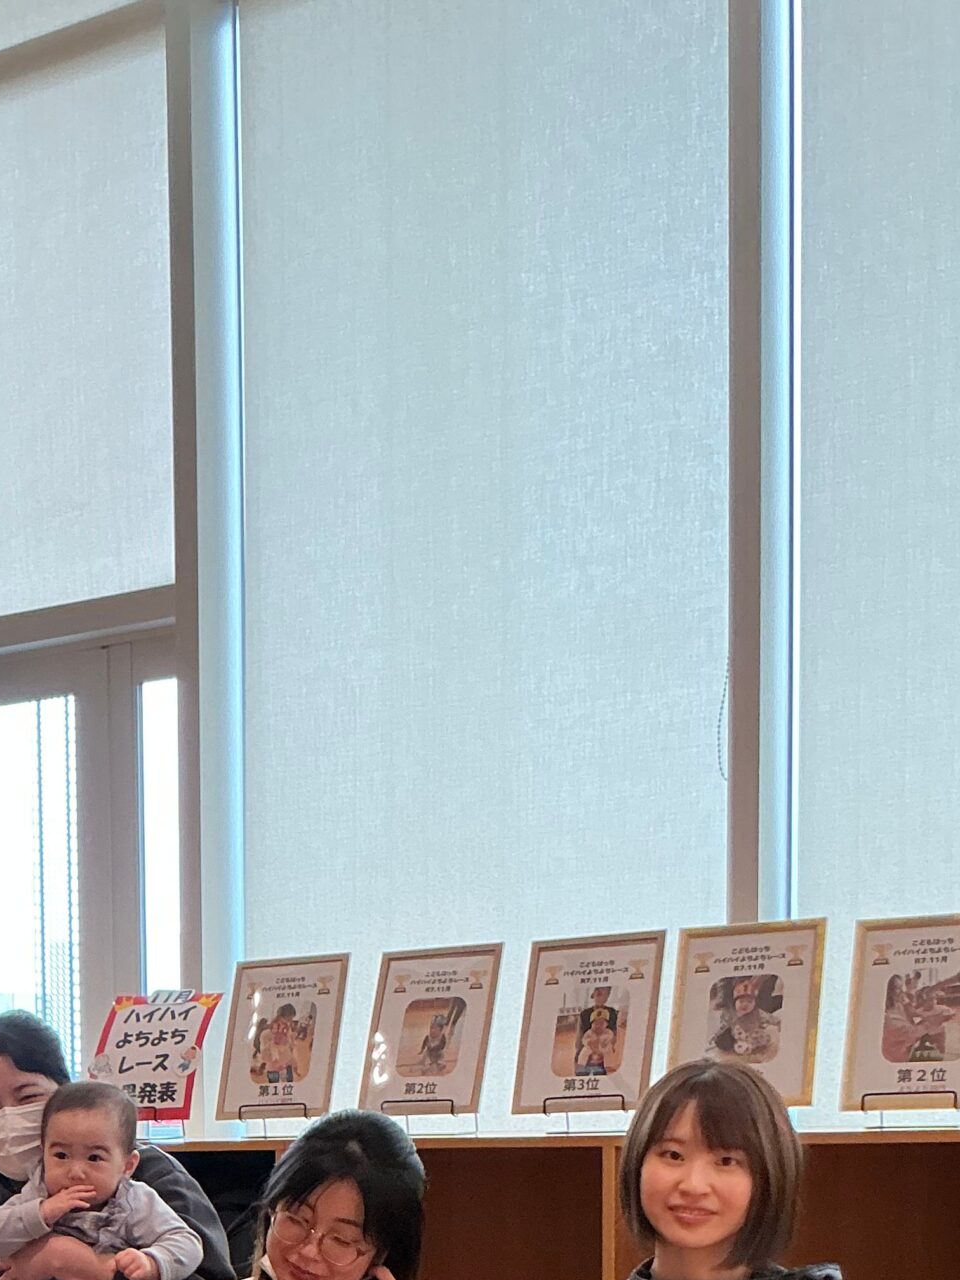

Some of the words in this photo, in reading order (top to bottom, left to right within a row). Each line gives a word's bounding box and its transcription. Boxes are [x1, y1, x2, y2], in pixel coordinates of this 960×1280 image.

[713, 953, 786, 964] ハイハイよちよちレース
[563, 967, 629, 977] ハイハイよちよちレース
[151, 990, 192, 1004] 11月
[123, 1005, 197, 1023] ハイハイ
[115, 1028, 189, 1048] よちよち
[118, 1053, 170, 1074] レース
[897, 1068, 947, 1083] 第2位
[258, 1084, 294, 1097] 第1位
[404, 1081, 438, 1095] 第2位
[563, 1077, 600, 1091] 第3位
